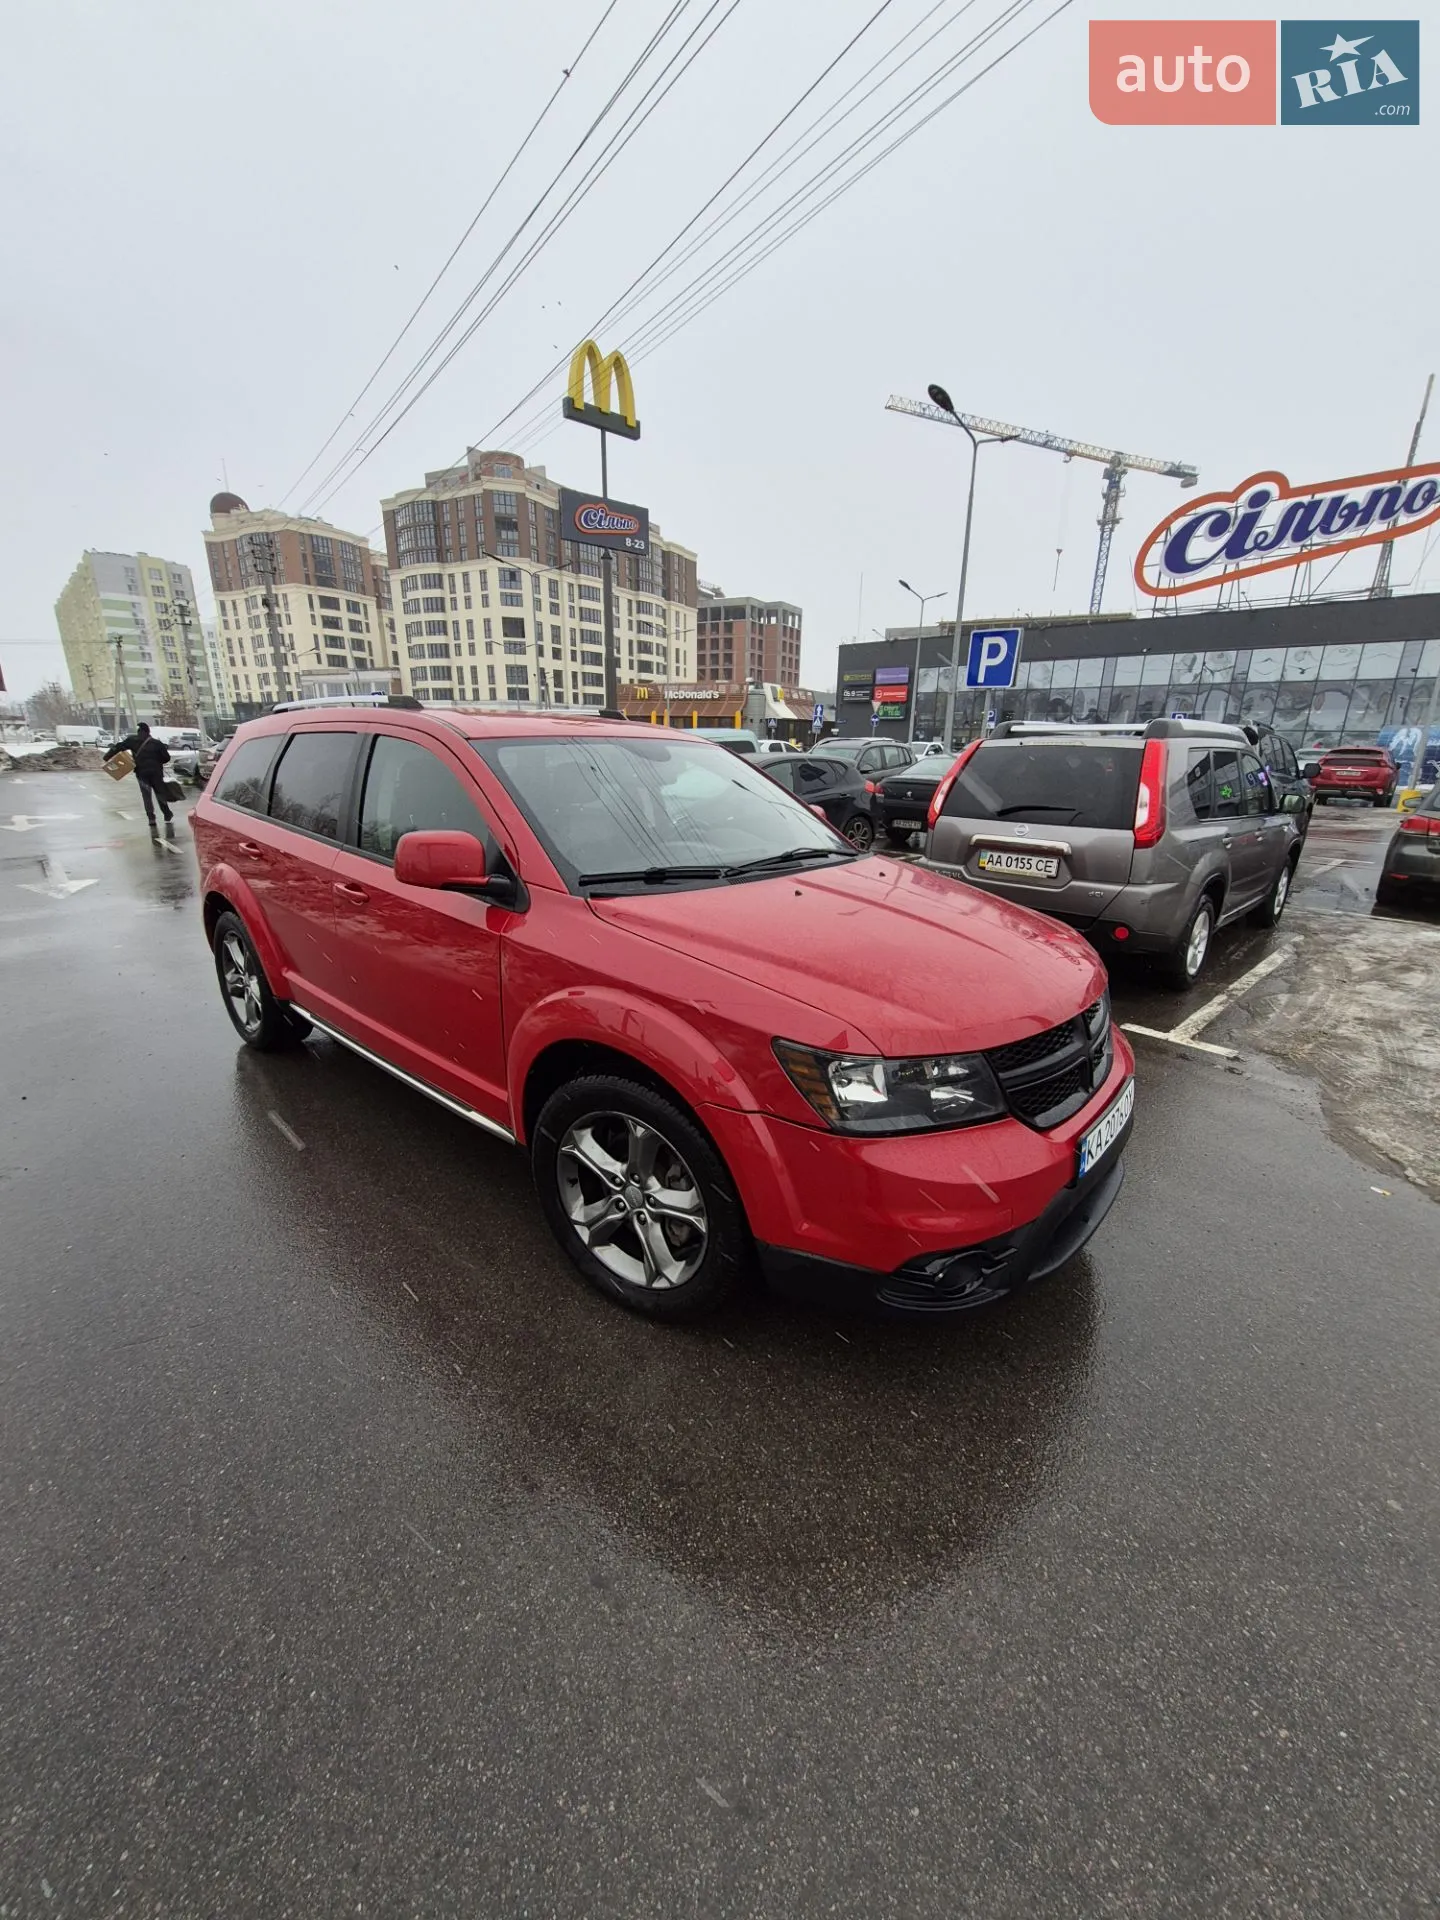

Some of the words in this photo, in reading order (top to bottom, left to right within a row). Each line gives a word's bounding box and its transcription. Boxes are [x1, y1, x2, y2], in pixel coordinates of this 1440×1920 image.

[580, 508, 637, 530] Сільпо
[1161, 478, 1440, 577] Сільпо
[625, 537, 645, 549] 8-23
[976, 636, 1008, 683] P
[664, 689, 720, 699] McDonald's
[986, 853, 1003, 867] AA
[1005, 855, 1033, 871] 0155
[1035, 859, 1055, 873] CE
[1086, 1128, 1103, 1165] KA
